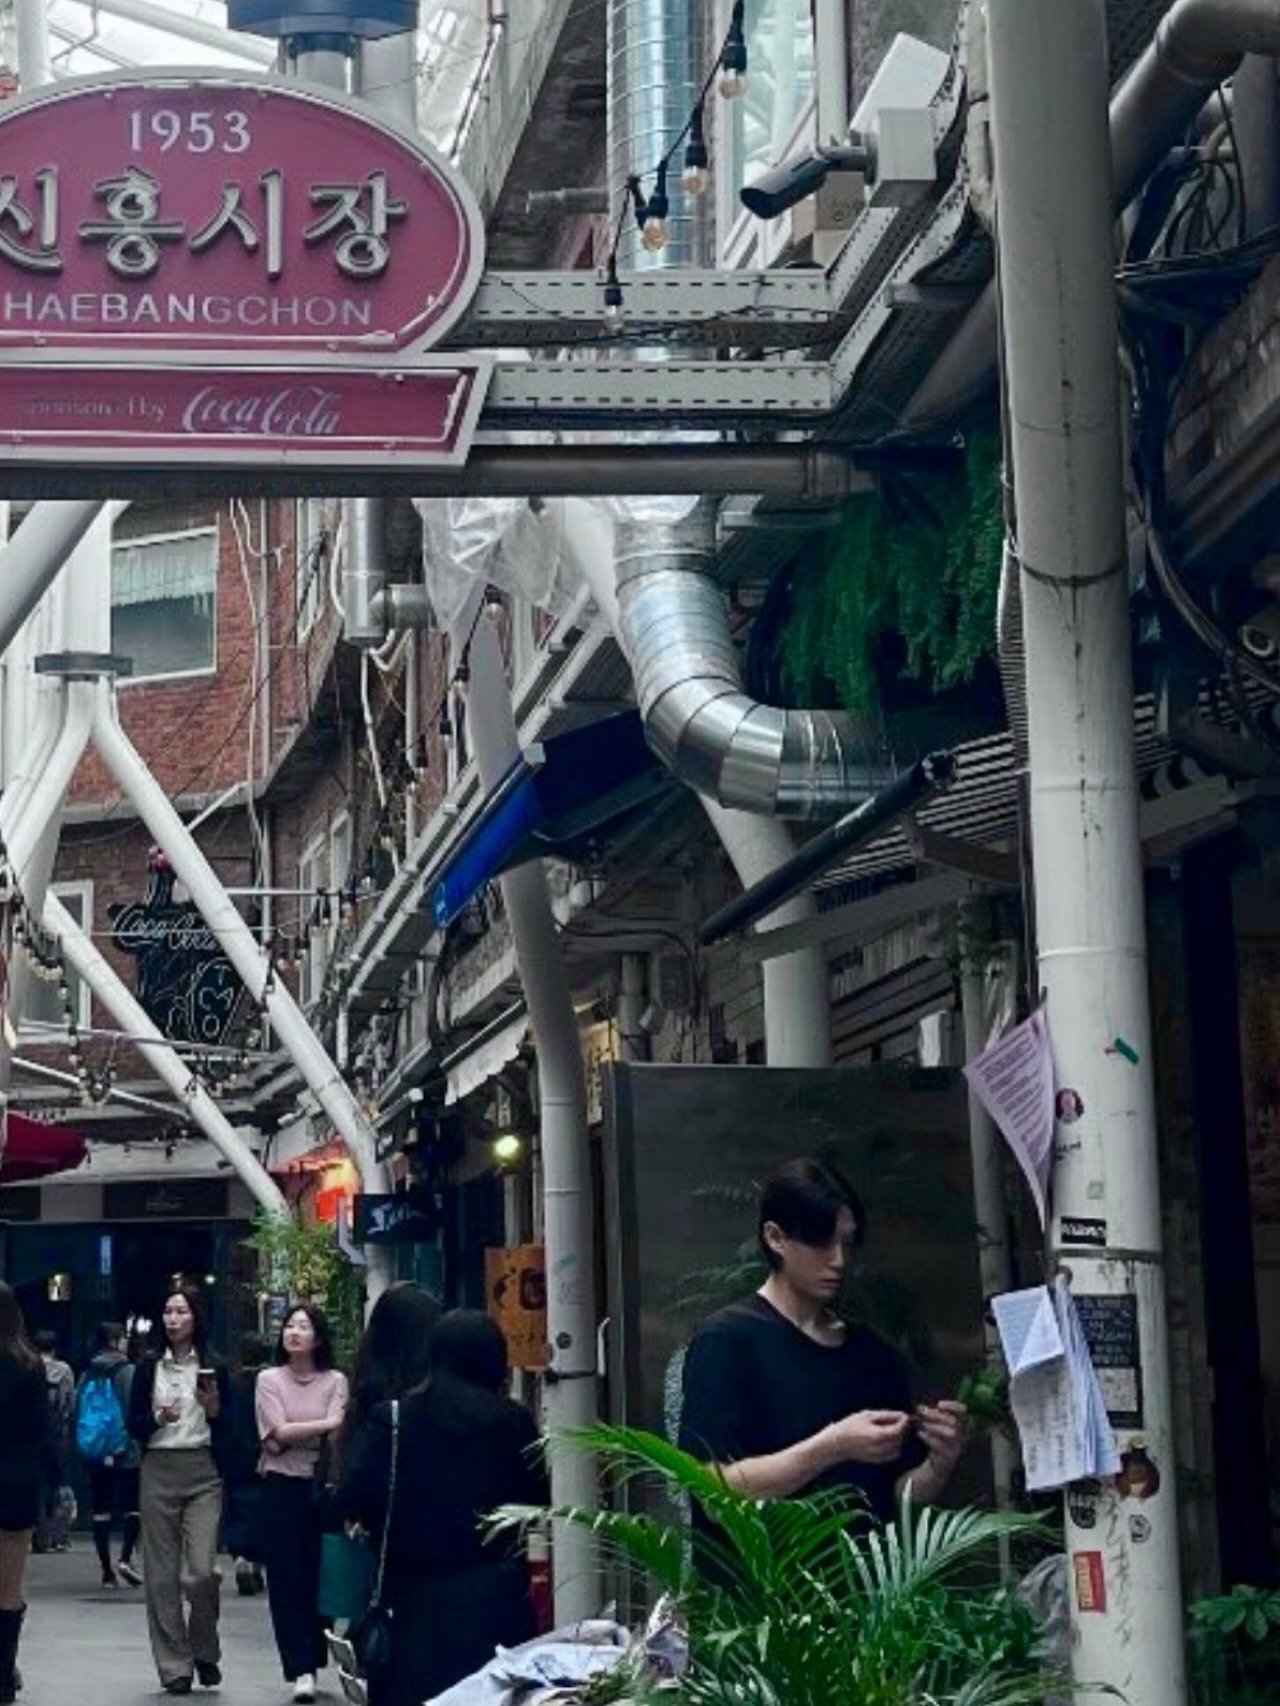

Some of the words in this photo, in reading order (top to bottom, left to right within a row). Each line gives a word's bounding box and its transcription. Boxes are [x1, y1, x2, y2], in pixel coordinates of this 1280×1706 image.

[129, 110, 251, 153] 1953
[0, 164, 409, 279] 신흥시장
[4, 292, 371, 326] HAEBANGCHON
